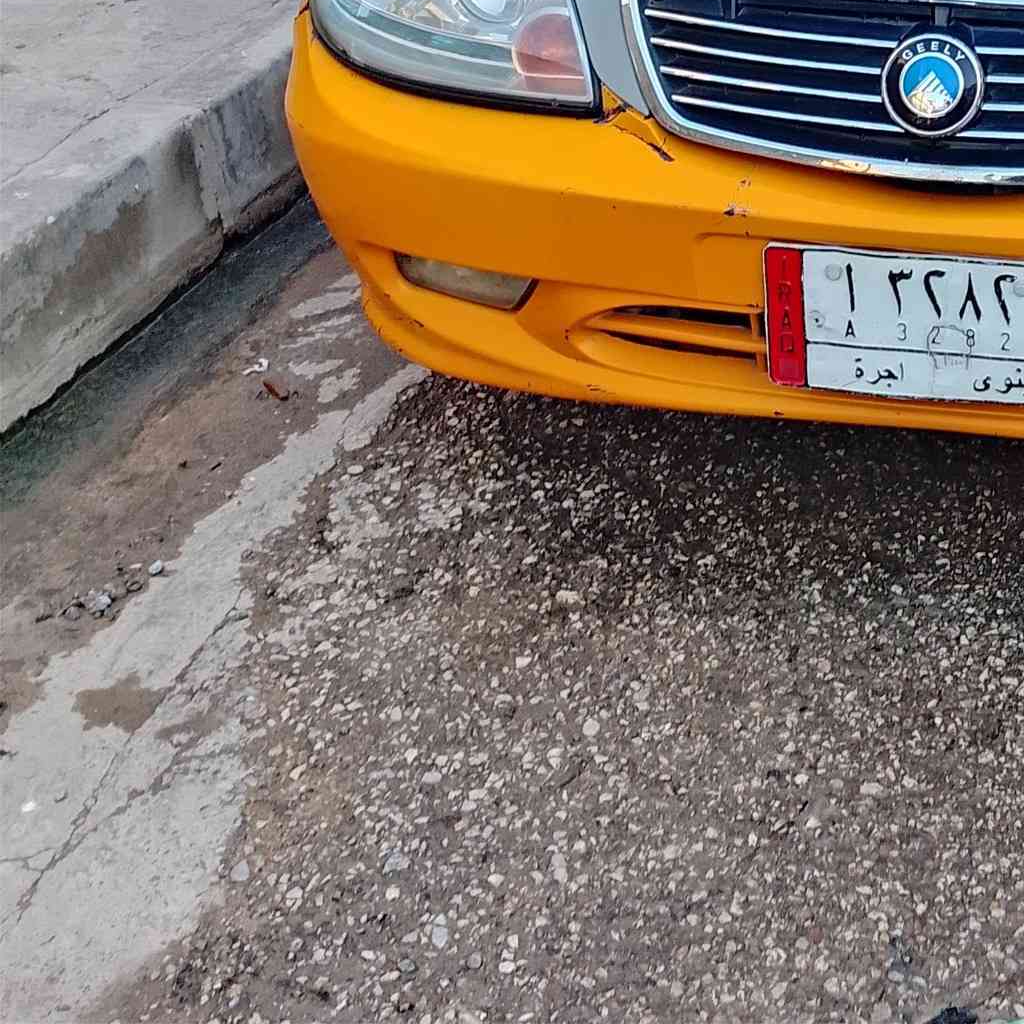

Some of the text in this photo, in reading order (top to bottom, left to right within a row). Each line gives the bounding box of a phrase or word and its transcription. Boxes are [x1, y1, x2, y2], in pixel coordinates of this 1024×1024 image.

[902, 41, 965, 61] GEELY
[844, 319, 856, 339] A
[854, 358, 904, 387] اجرة
